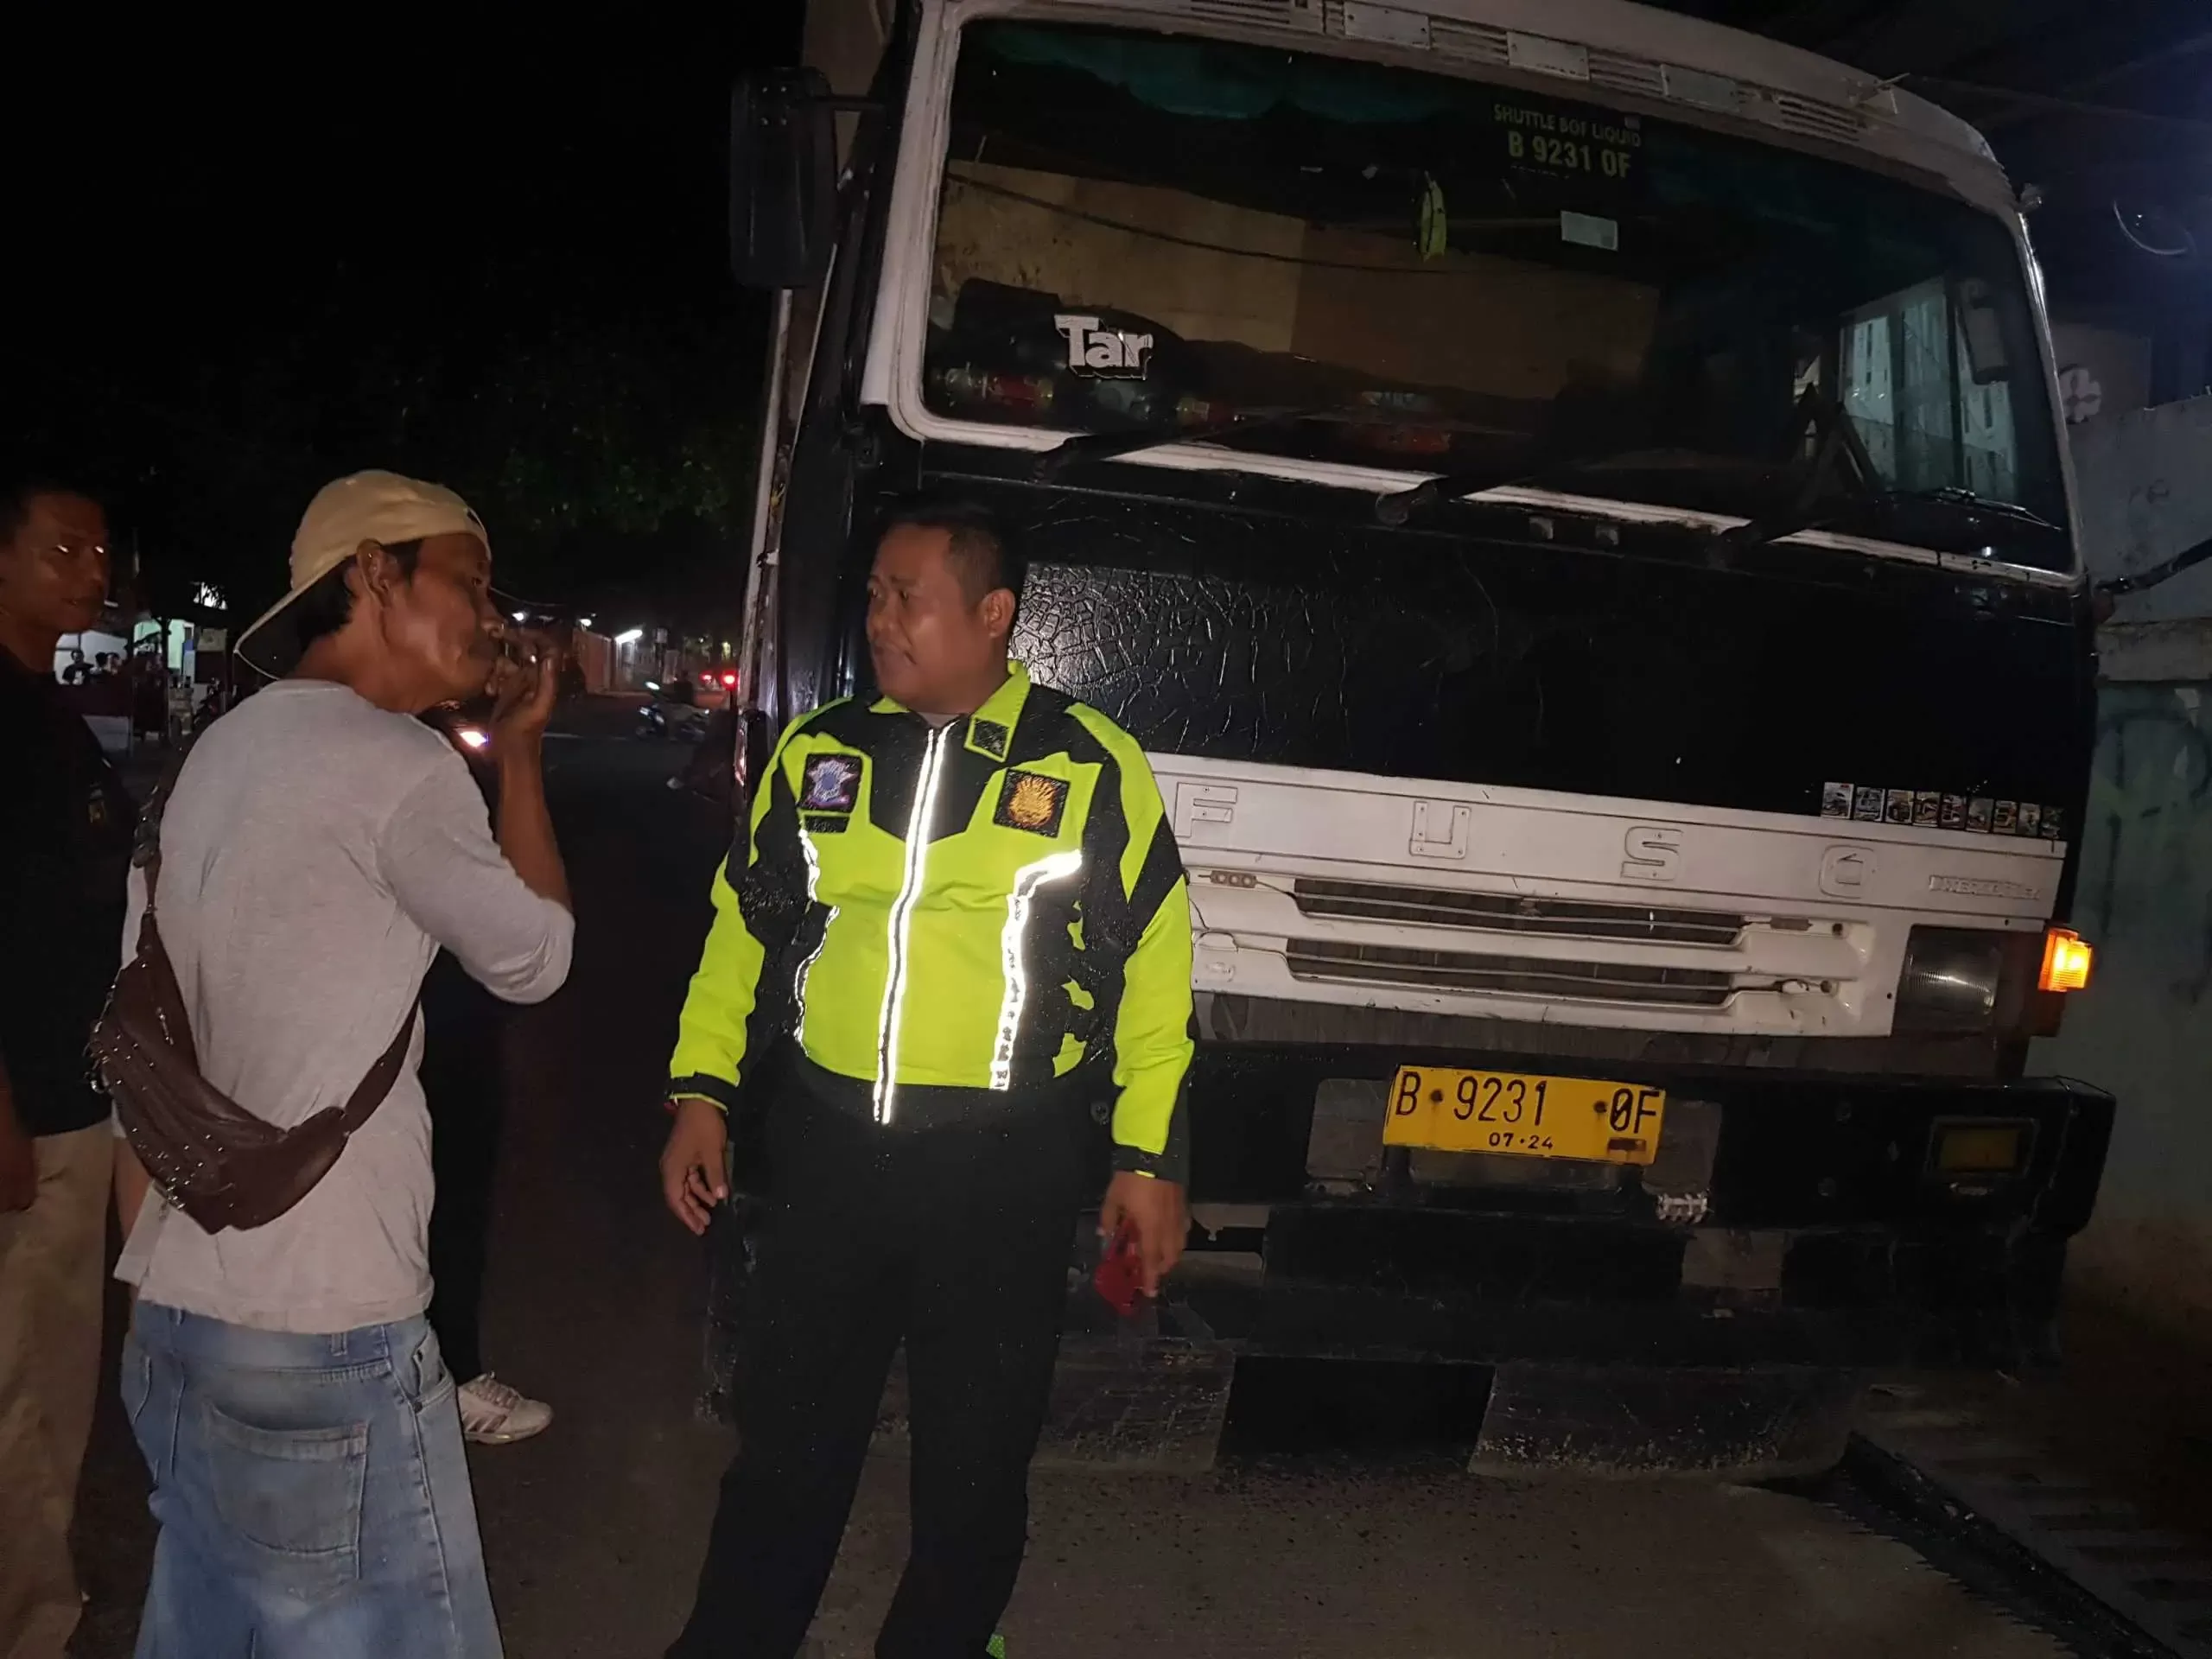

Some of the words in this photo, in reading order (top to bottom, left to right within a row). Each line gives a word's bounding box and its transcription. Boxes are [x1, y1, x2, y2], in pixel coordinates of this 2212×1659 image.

[1494, 104, 1555, 130] SHUTTLE
[1592, 123, 1641, 147] LIQUID
[1508, 130, 1524, 157] B
[1532, 135, 1592, 173] 9231
[1053, 314, 1154, 370] Tar
[1395, 1071, 1422, 1116] B
[1452, 1076, 1548, 1127] 9231
